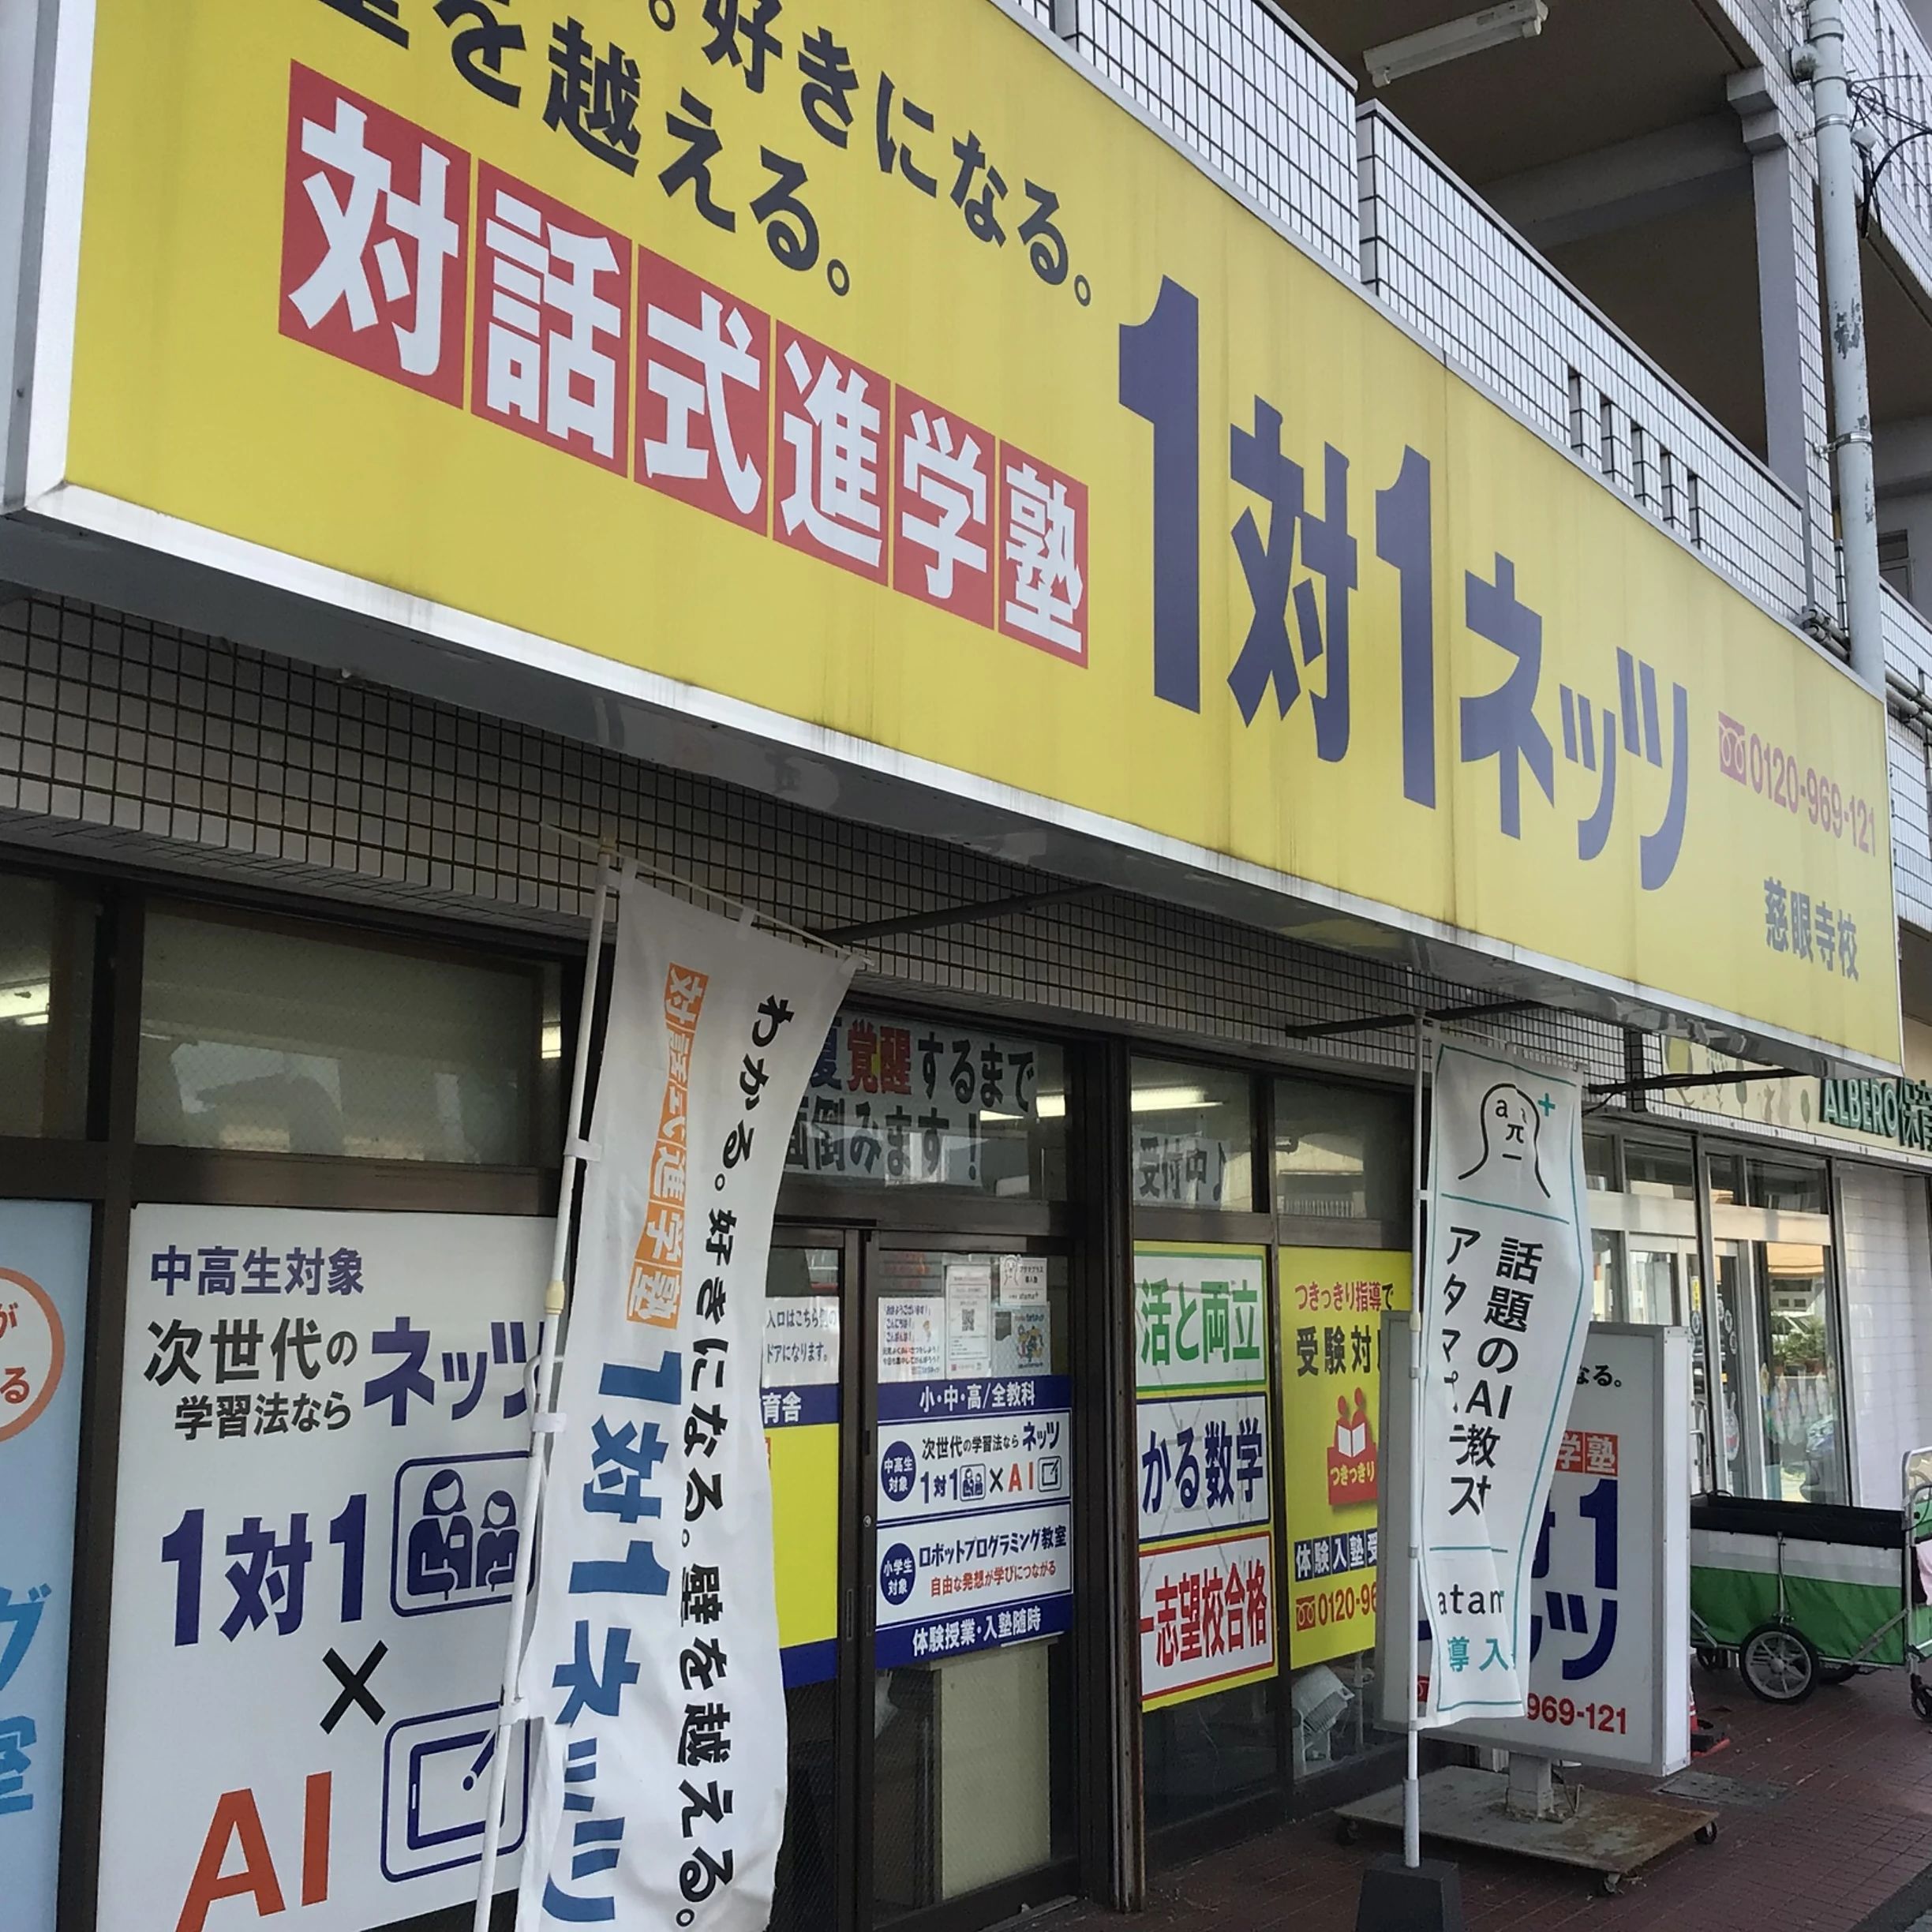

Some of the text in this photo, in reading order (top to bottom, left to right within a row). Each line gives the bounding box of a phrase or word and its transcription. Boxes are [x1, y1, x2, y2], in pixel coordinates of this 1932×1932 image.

[289, 96, 1083, 654] 対話式進学塾
[1119, 274, 1688, 892] 1対1ネッツ
[1749, 732, 1877, 857] 0120-969-121
[1763, 875, 1859, 982] 慈眼寺校
[627, 964, 706, 1325] 対話式進学塾
[150, 1245, 365, 1297] 中高生対象
[144, 1316, 358, 1387] 次世代の
[1296, 1324, 1381, 1377] 受験対
[174, 1391, 352, 1441] 学習法なら
[1022, 1421, 1060, 1451] ネッツ
[884, 1458, 914, 1473] 中高生
[889, 1477, 908, 1493] 対象
[161, 1492, 368, 1647] 1対1
[884, 1557, 913, 1577] 小学生
[887, 1578, 908, 1596] 対象
[175, 1770, 332, 1932] AI
